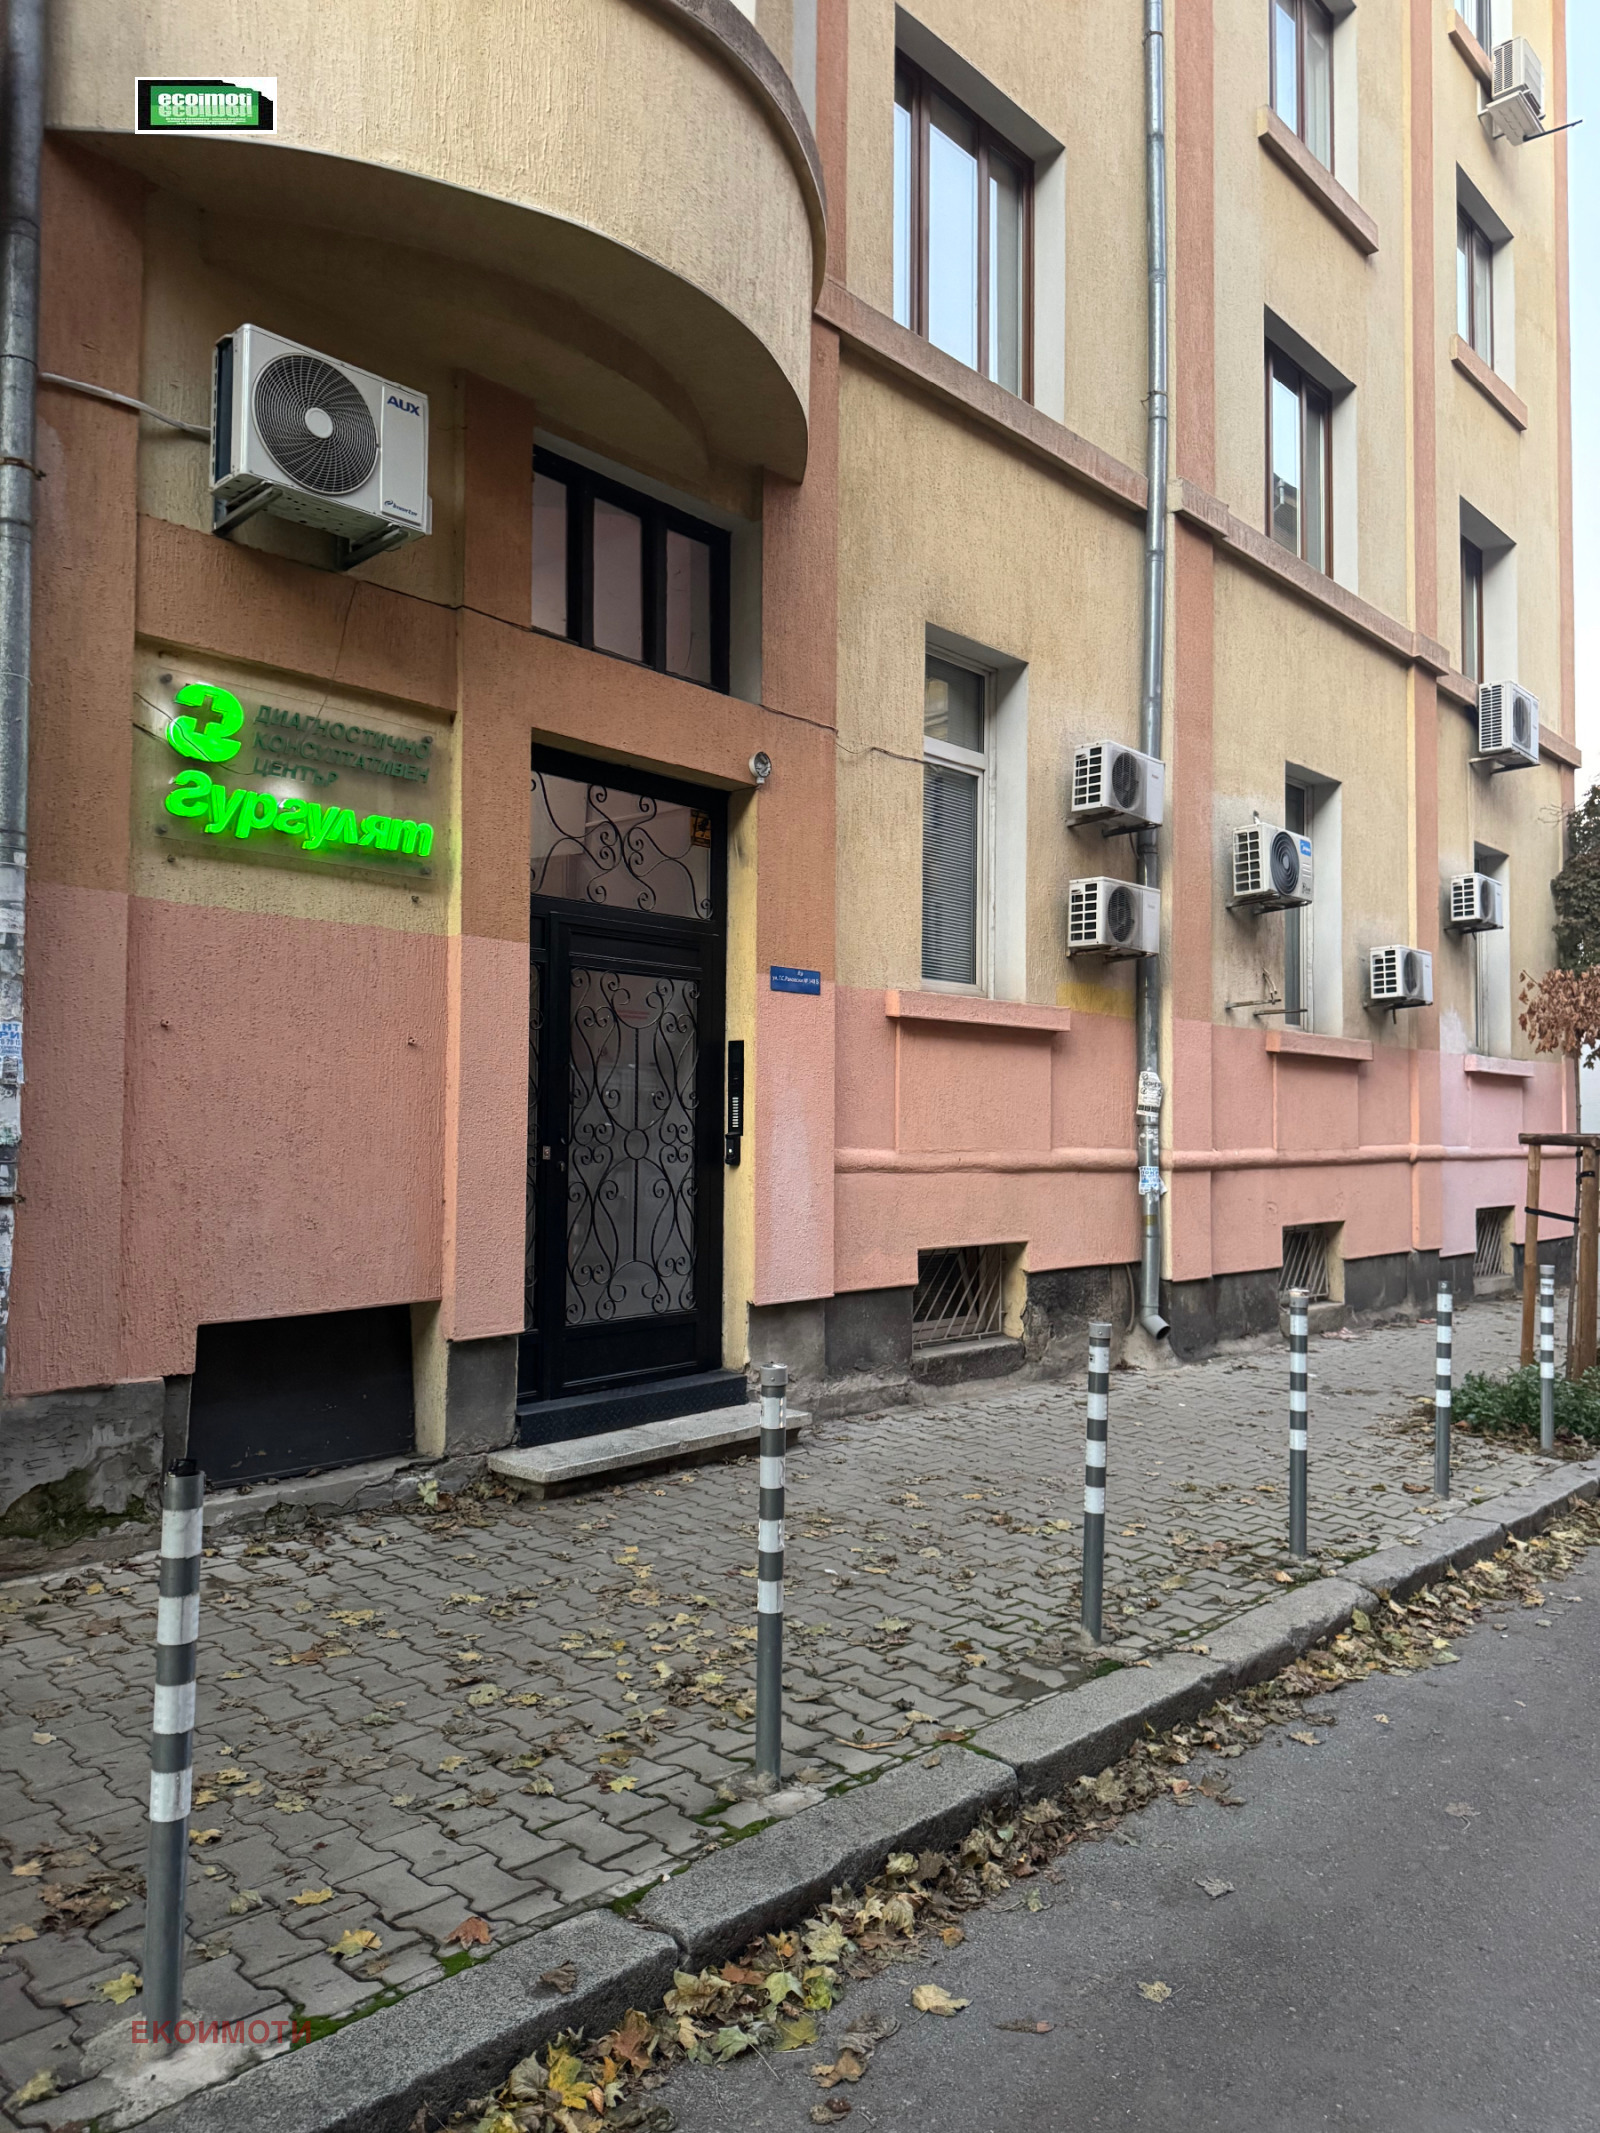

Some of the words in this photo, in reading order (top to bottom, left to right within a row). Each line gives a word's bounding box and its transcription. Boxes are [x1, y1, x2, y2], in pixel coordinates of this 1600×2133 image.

[386, 395, 420, 416] AUX
[253, 704, 432, 760] ДИАГНОСТИЧНО
[252, 757, 339, 787] ЦЕНТЪР
[253, 732, 431, 784] КОНСУЛТАТИВЕН
